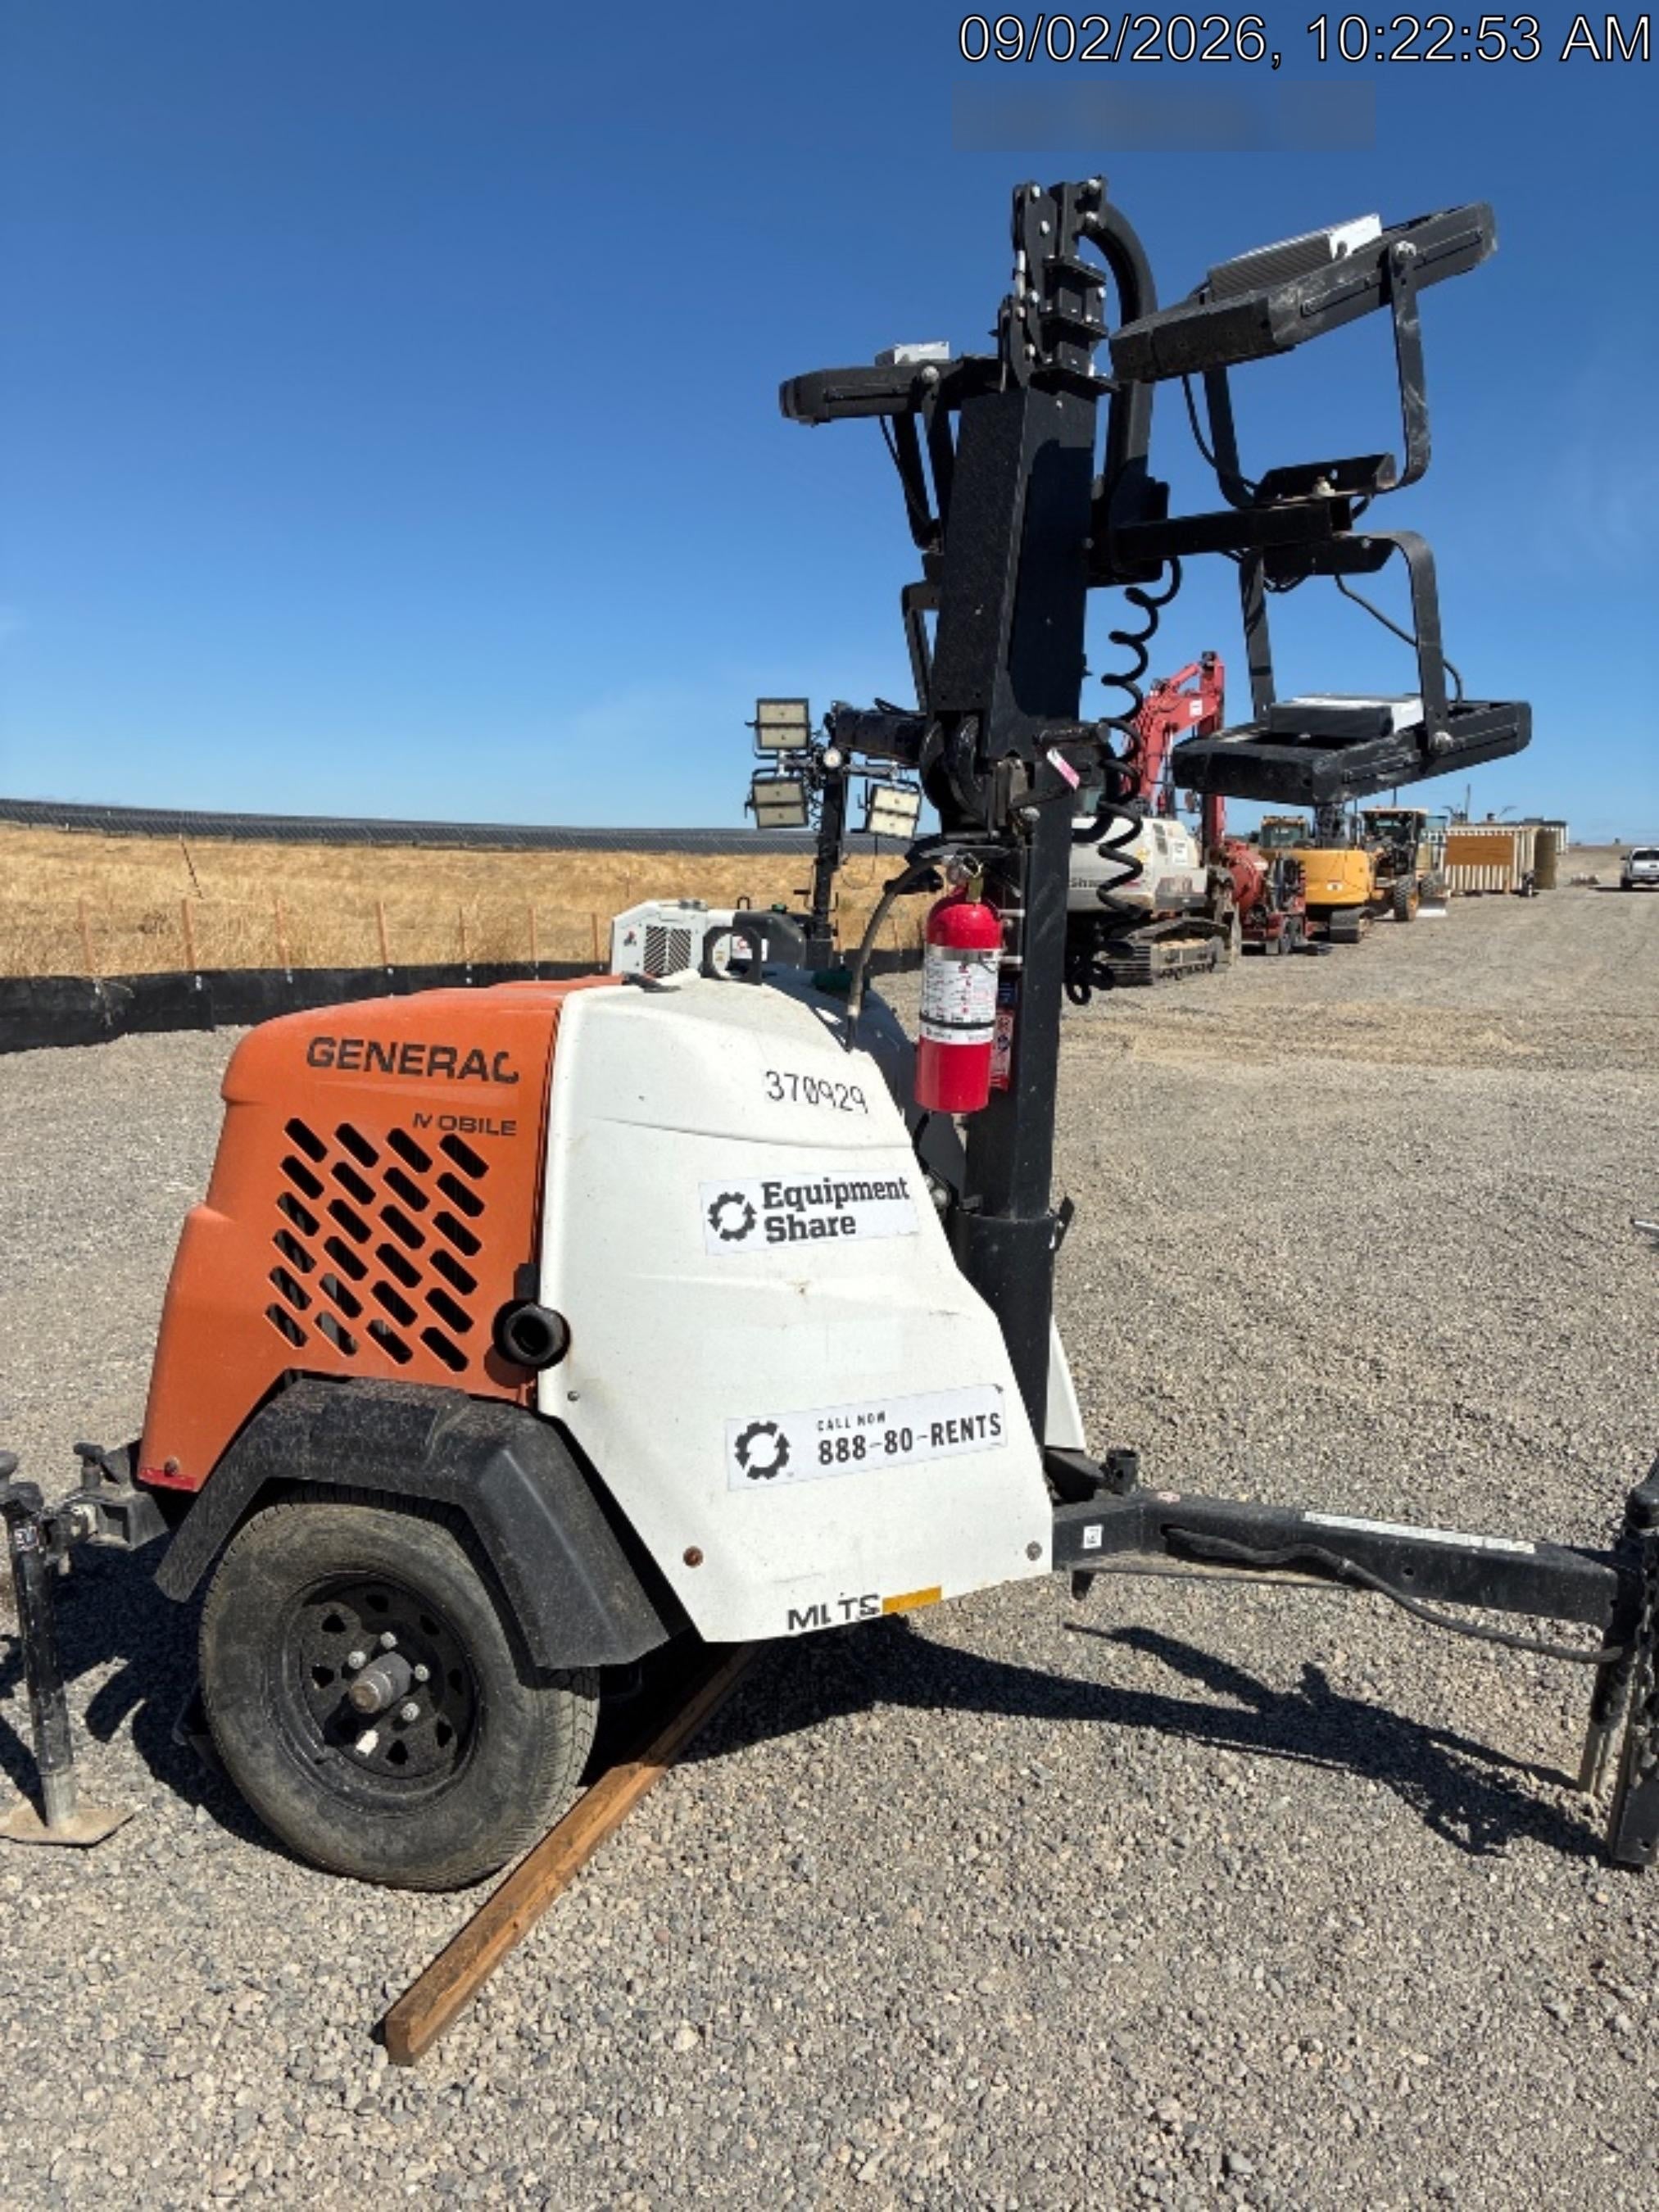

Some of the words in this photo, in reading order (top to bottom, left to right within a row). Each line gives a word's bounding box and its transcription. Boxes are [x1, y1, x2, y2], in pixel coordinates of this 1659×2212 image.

[306, 1036, 520, 1085] GENERAC
[764, 1068, 869, 1114] 370929
[761, 1176, 910, 1213] Equipment
[764, 1214, 856, 1244] Share
[817, 1416, 851, 1432] CALL
[857, 1410, 886, 1426] NOW
[818, 1412, 1002, 1466] 888-80-RENTS
